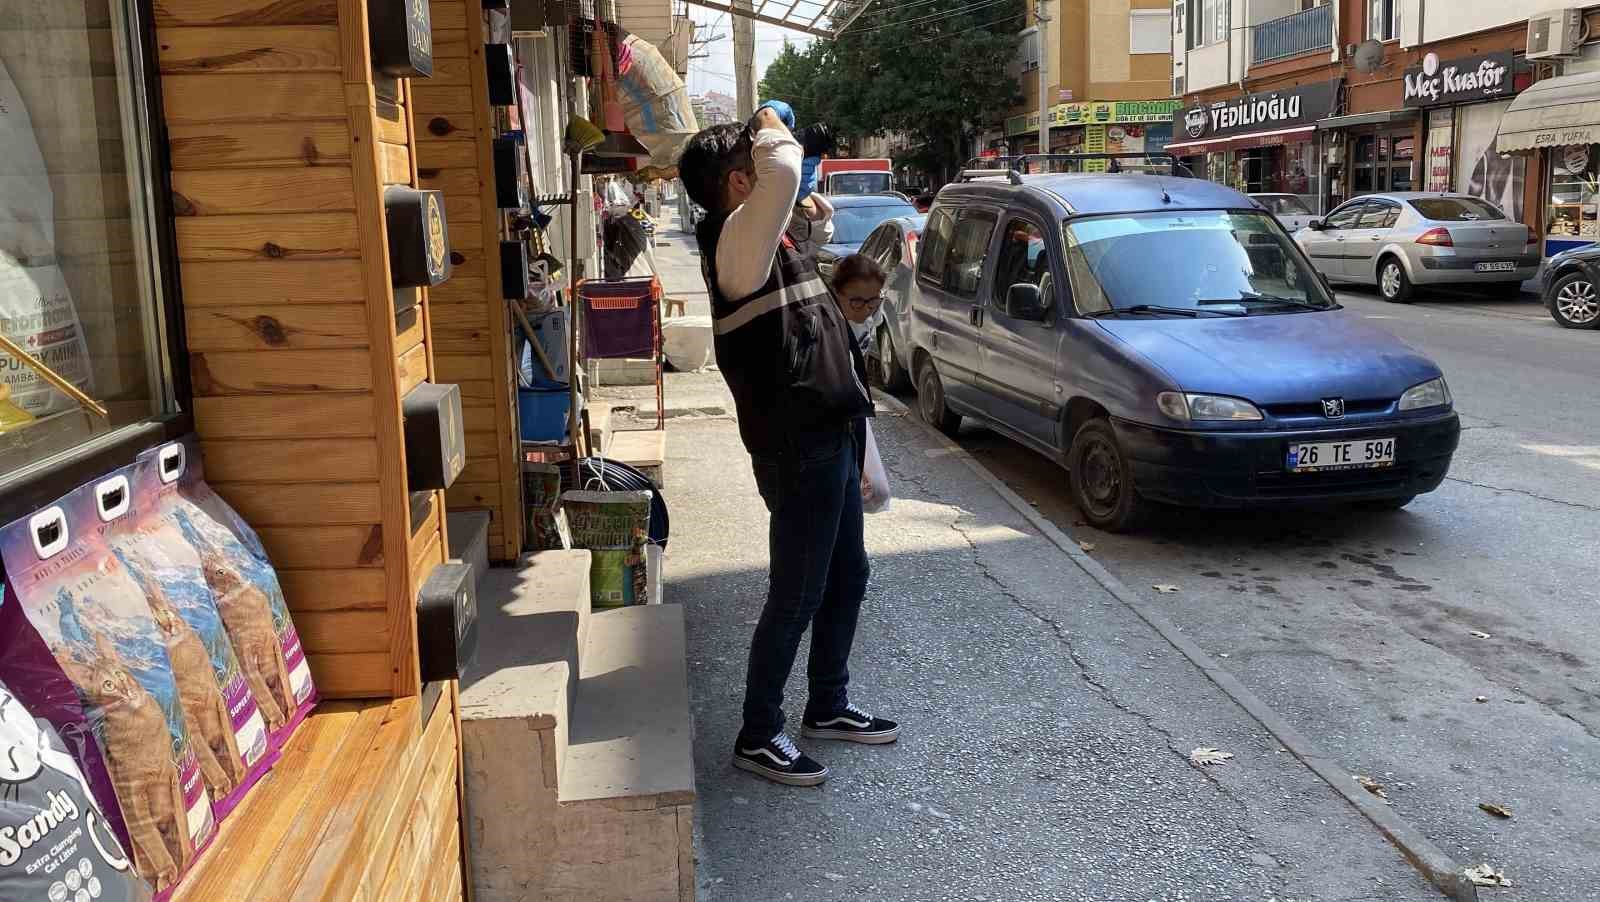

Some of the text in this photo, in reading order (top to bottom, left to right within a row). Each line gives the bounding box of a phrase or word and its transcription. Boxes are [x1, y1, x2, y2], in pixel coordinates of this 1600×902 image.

[1404, 71, 1440, 101] Meç
[1535, 129, 1592, 144] ESRA YUFKA
[1299, 440, 1393, 465] 26 TE 594
[0, 789, 79, 866] Sandy
[25, 853, 51, 875] Extra
[44, 843, 78, 874] Cat Litter
